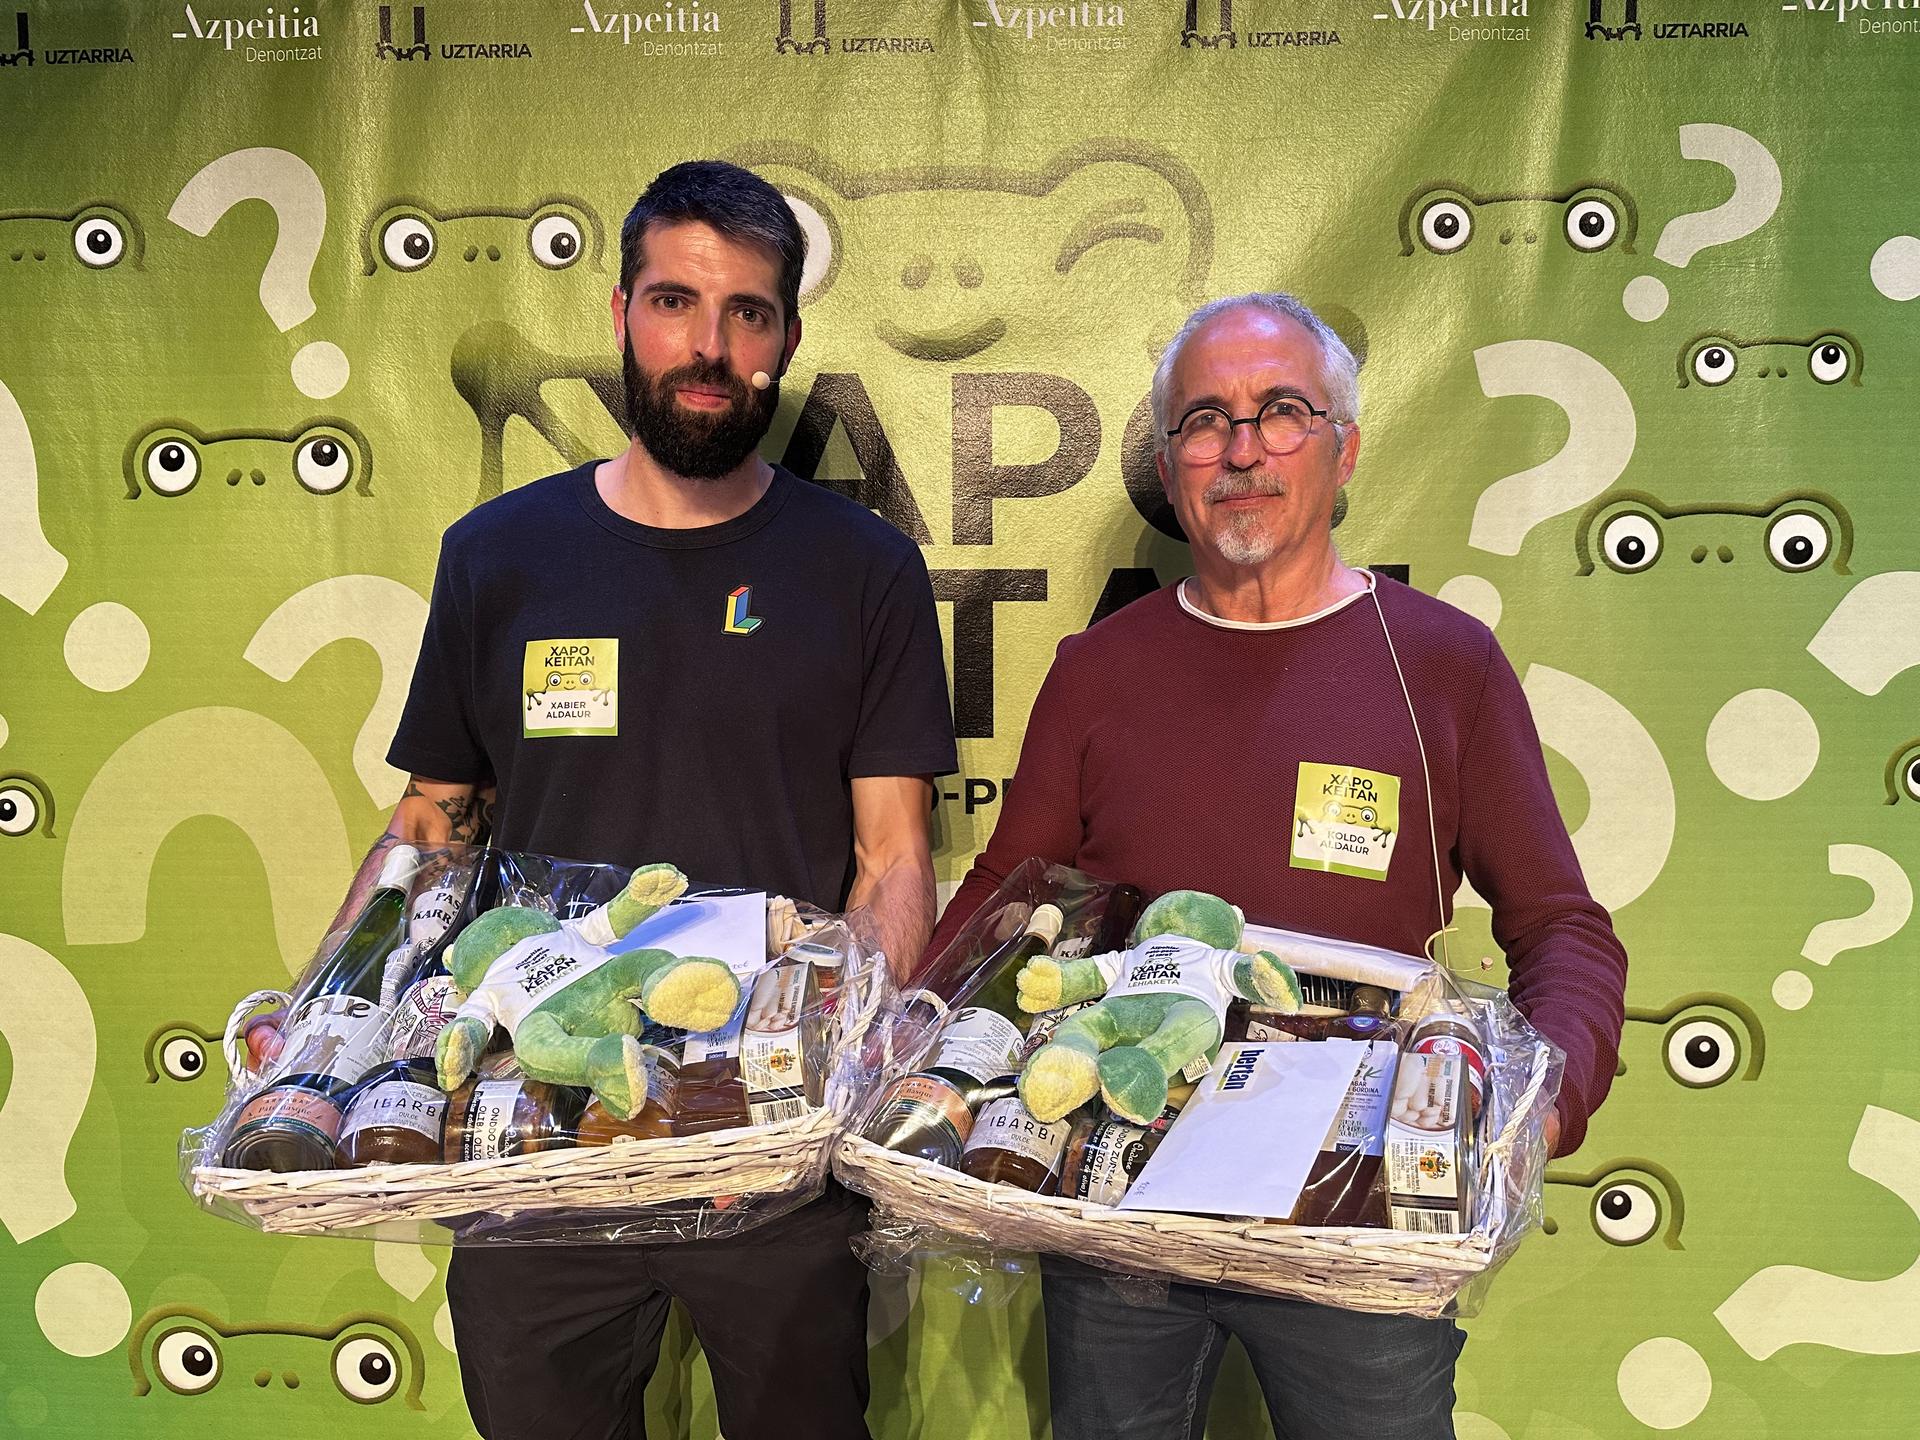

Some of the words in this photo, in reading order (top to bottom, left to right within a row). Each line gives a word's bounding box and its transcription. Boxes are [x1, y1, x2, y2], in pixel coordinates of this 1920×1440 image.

[172, 3, 320, 50] Azpeitia
[570, 0, 720, 44] Azpeitia
[972, 0, 1125, 39] Azpeitia
[1859, 18, 1920, 34] Denont
[1247, 30, 1342, 48] UZTARRIA
[1449, 26, 1531, 41] Denontzat
[1653, 22, 1749, 40] UZTARRIA
[441, 43, 532, 60] UZTARRIA
[643, 41, 723, 57] Denontzat
[842, 38, 935, 54] UZTARRIA
[1046, 36, 1129, 51] Denontzat
[45, 48, 134, 65] UZTARRIA
[246, 46, 322, 63] Denontzat
[550, 646, 590, 657] XAPO
[544, 656, 595, 668] KEITAN
[551, 701, 586, 710] XABIER
[546, 710, 591, 719] ALDALUR
[1330, 774, 1373, 790] XAPO
[1323, 784, 1378, 803] KEITAN
[1328, 831, 1365, 844] KOLDO
[1320, 840, 1370, 856] ALDALUR
[525, 957, 577, 993] KEITAN
[526, 957, 565, 983] XAPO
[1130, 971, 1181, 982] KEITAN
[1138, 963, 1176, 974] XAPO
[529, 964, 582, 998] LEHIAKETA
[1128, 979, 1180, 988] LEHIAKETA
[1223, 1049, 1265, 1090] bertan
[990, 1115, 1055, 1146] IBARBI
